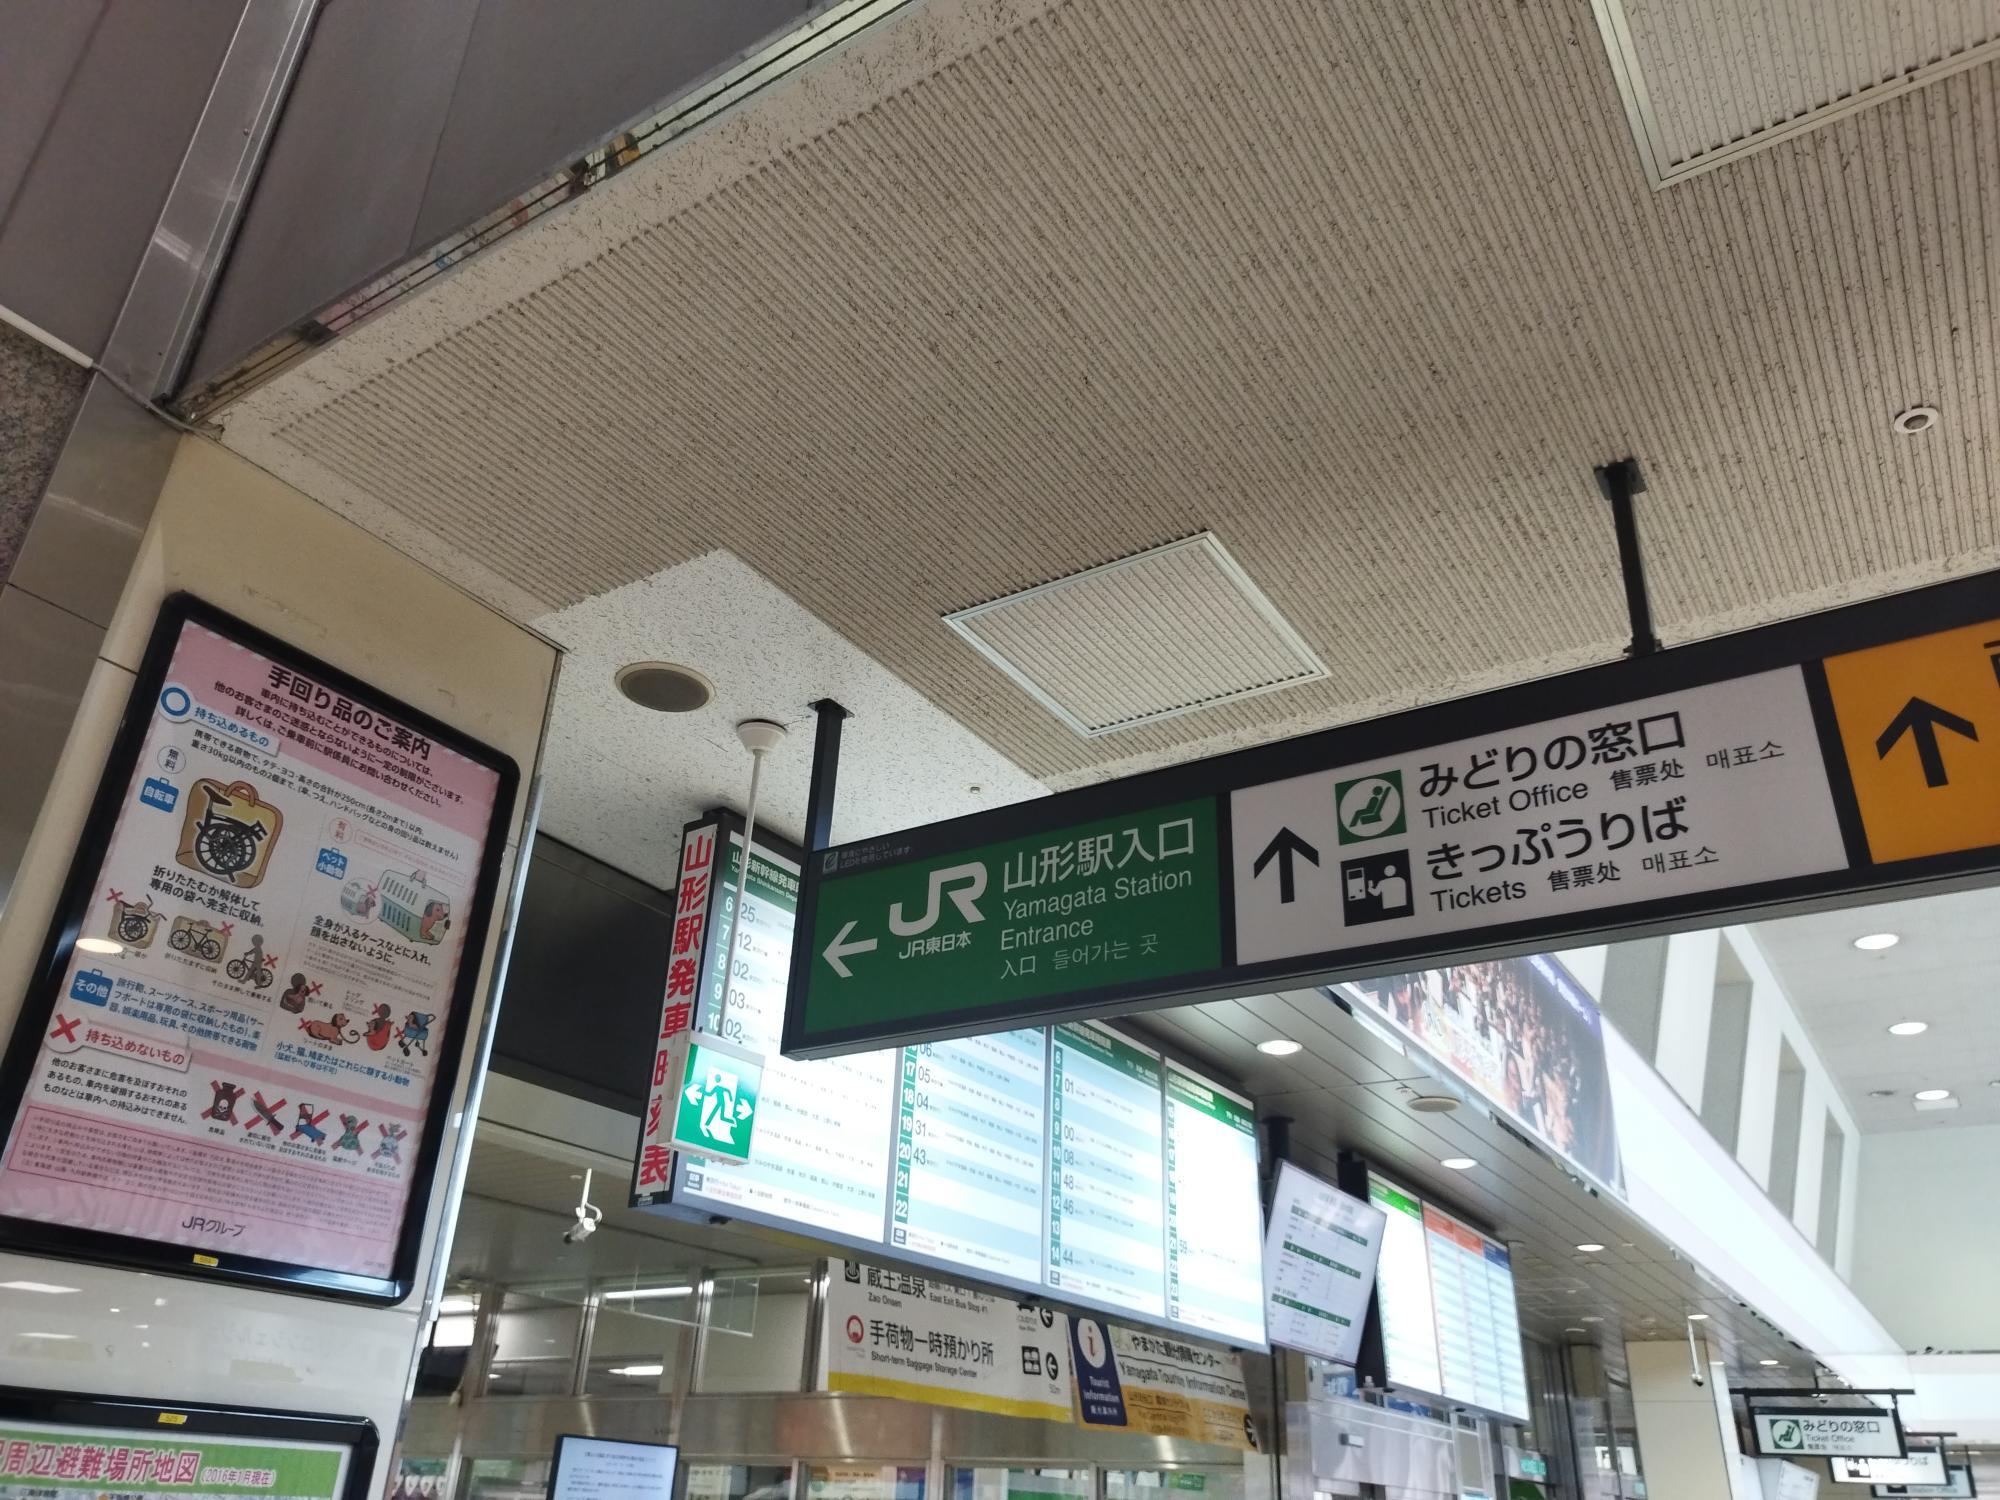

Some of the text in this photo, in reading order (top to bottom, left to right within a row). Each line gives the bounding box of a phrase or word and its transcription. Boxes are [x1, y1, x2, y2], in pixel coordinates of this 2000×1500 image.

[192, 704, 271, 750] 持ち込めるもの
[265, 663, 433, 761] 手回り品のご案内
[163, 746, 180, 773] 無料
[1421, 711, 1686, 798] みどりの窓口
[141, 782, 177, 808] 自転車
[1422, 739, 1785, 829] Ticket Office 售票处 매표소
[1004, 817, 1194, 893] 山形駅入口
[1427, 796, 1689, 881] きっぷうりば
[151, 864, 261, 912] 折りたたむか解体して
[1004, 869, 1192, 921] Yamagata Station
[1431, 844, 1719, 912] Tickets 售票处 매표소
[147, 877, 267, 928] 専用の袋へ完全に収納。
[725, 896, 756, 923] 6 25
[889, 862, 988, 936] JR
[308, 925, 397, 965] 顔を出さないように。
[722, 924, 752, 952] 7 12
[899, 931, 972, 959] JR東日本
[1001, 918, 1093, 951] Entrance
[718, 954, 749, 981] 8 02
[1000, 933, 1160, 980] 入口 들어가는 곳
[73, 977, 110, 998] その他
[713, 983, 746, 1009] 9 03
[725, 1018, 742, 1039] 02
[84, 1028, 186, 1066] 持ち込めないもの
[45, 1069, 189, 1111] あるもの、車内を破損するおそれのある
[49, 1056, 189, 1098] 他のお客さまに危害を及ぼすおそれの
[905, 1063, 931, 1084] 17 05
[903, 1086, 929, 1110] 18 04
[902, 1115, 927, 1137] 19 31
[899, 1144, 926, 1165] 20 43
[897, 1172, 908, 1190] 21
[180, 1213, 247, 1240] JRグループ
[895, 1201, 908, 1219] 22
[869, 1319, 994, 1366] 手荷物一時預かり所
[1803, 1420, 1881, 1434] みどりの窓口
[0, 1439, 201, 1484] 周辺避難場所地図
